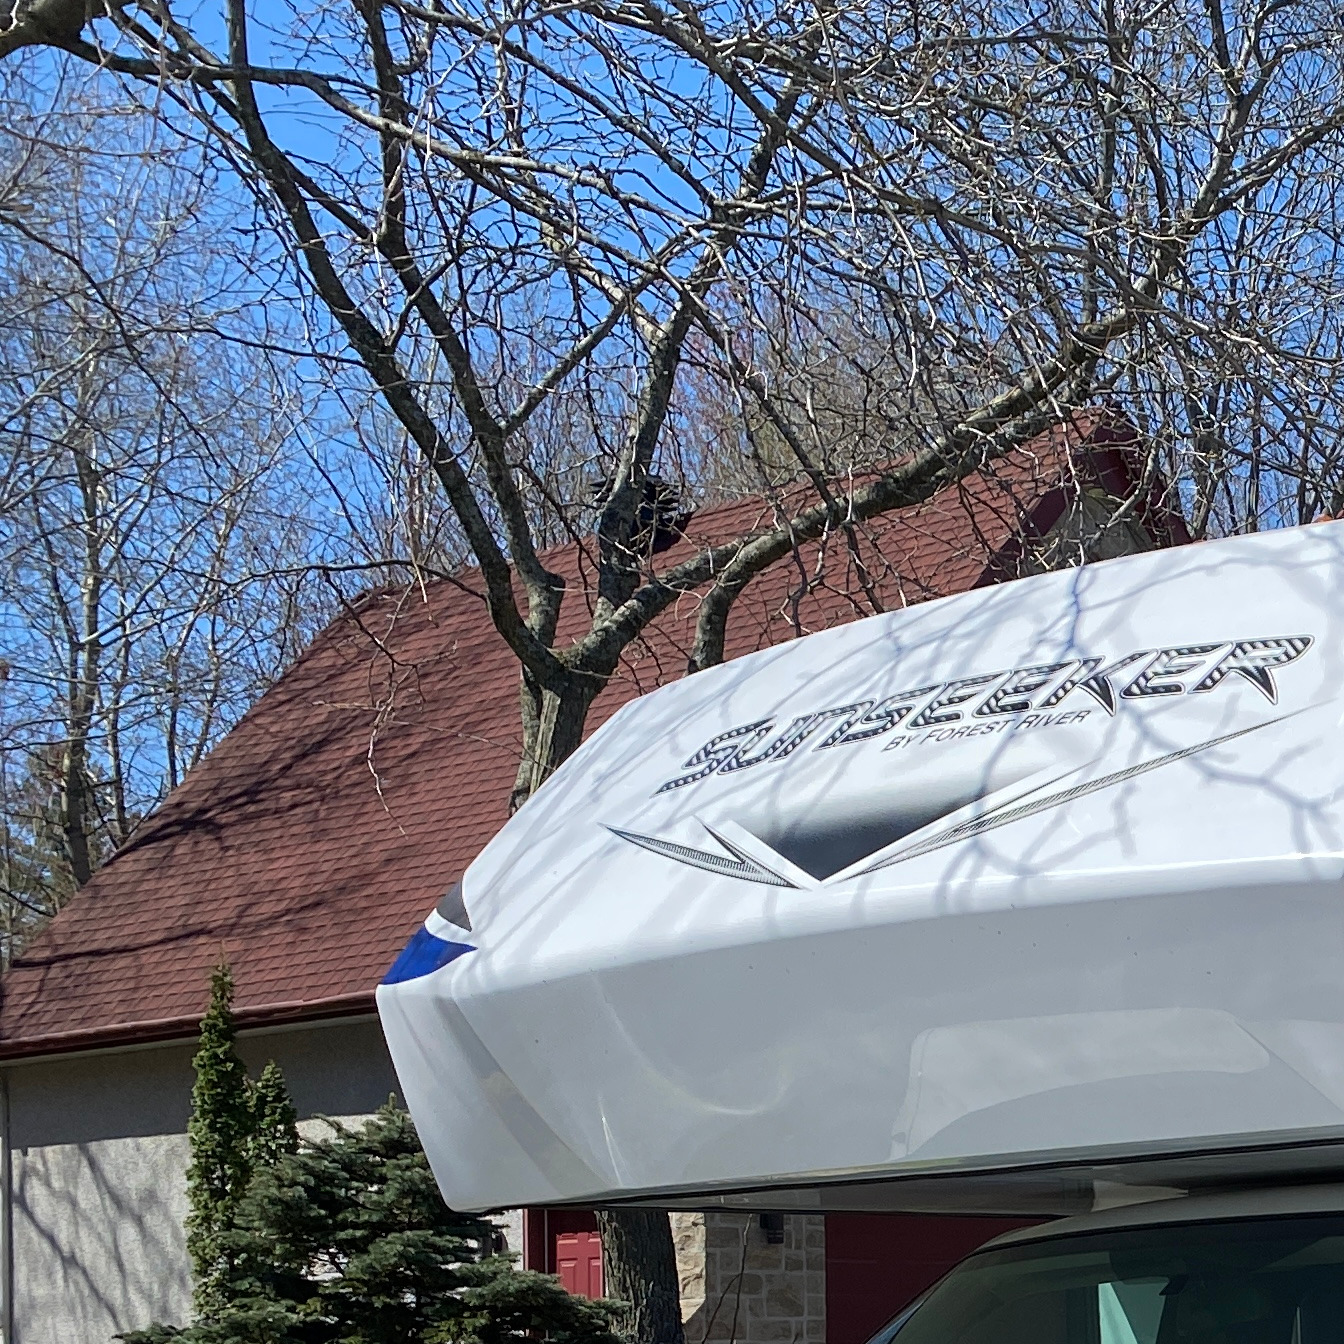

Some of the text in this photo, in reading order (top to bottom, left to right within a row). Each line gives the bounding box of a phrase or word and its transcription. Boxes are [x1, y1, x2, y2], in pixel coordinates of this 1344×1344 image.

[883, 709, 1090, 752] BY FOREST RIVER
